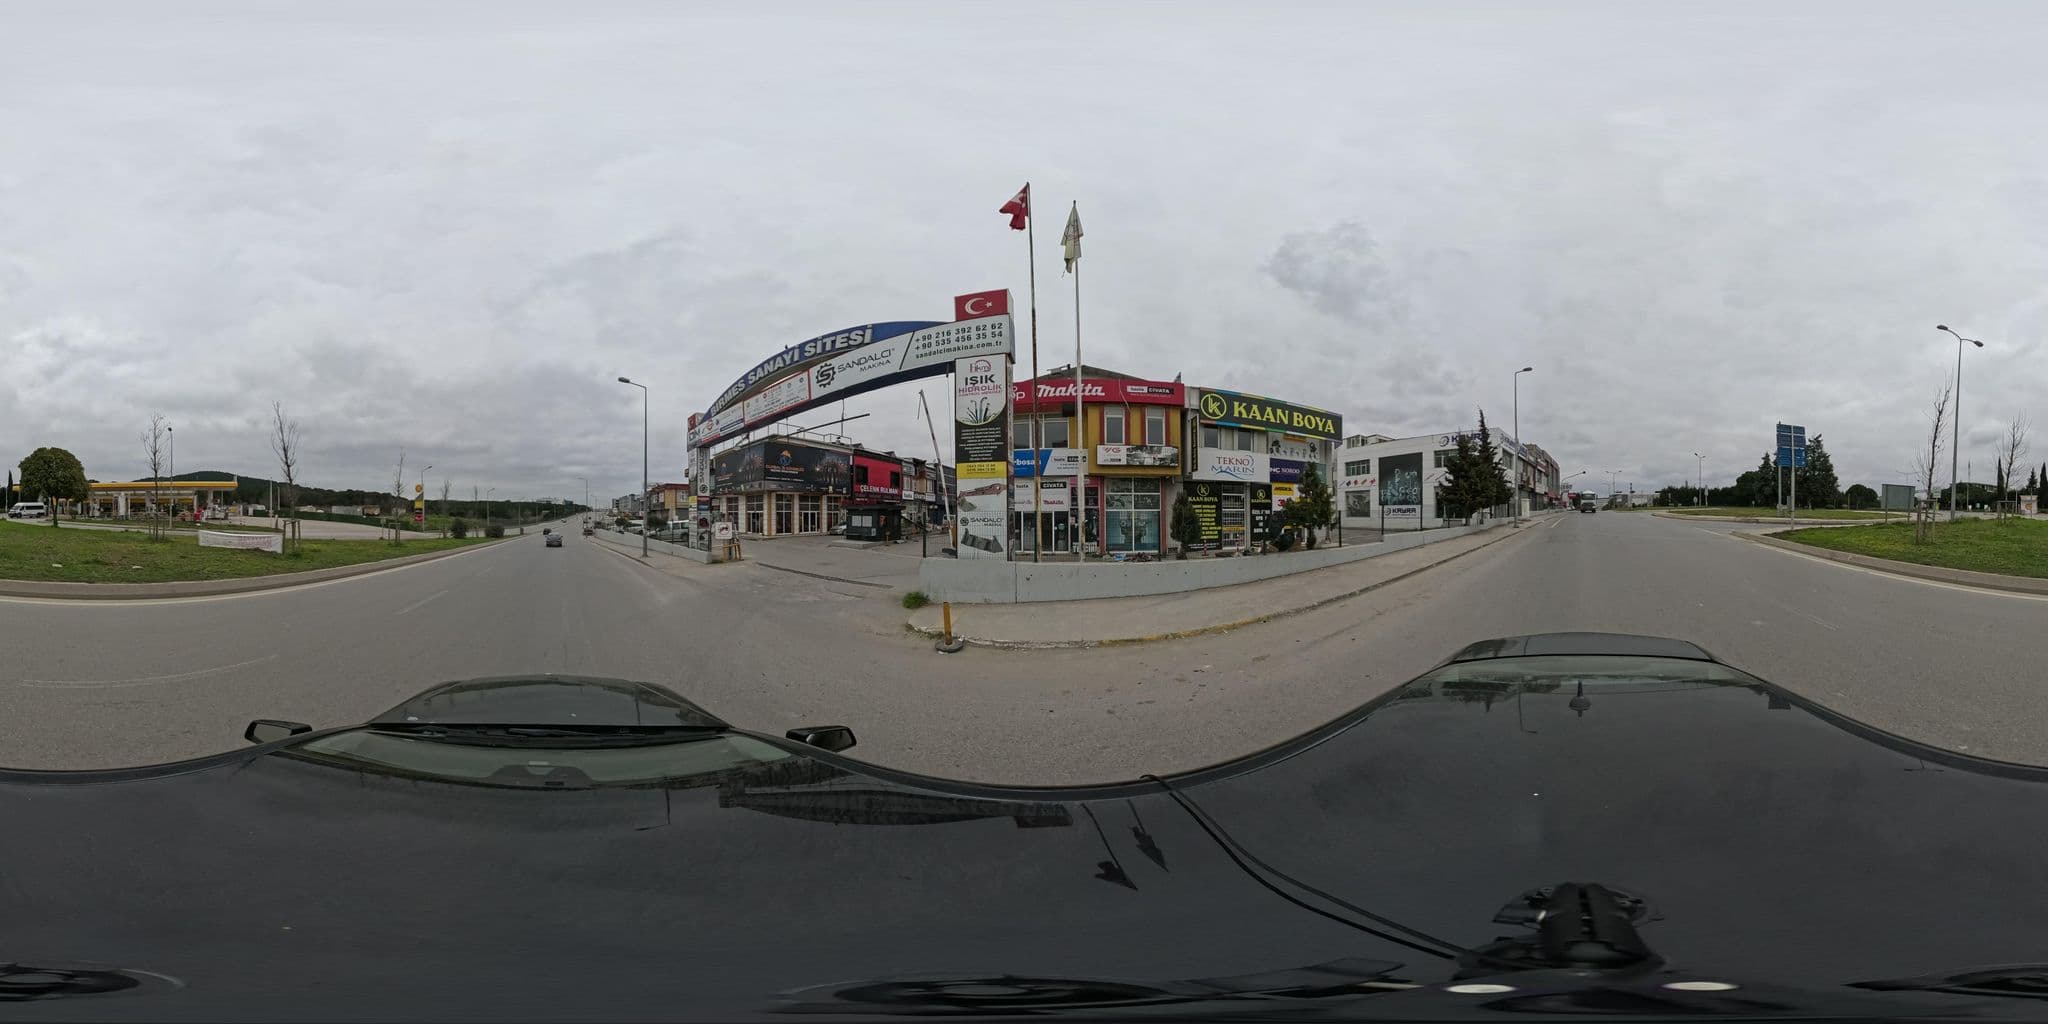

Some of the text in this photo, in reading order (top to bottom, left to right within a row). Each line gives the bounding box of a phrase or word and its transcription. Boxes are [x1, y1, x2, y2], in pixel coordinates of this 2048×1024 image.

[935, 330, 952, 339] 216
[955, 326, 972, 335] 392
[991, 322, 1003, 330] 62
[935, 337, 952, 347] 535
[955, 334, 972, 343] 456
[976, 332, 987, 340] 35
[991, 330, 1003, 338] 54
[748, 344, 800, 385] SANAYİ
[804, 324, 873, 358] SİTESİ
[1233, 401, 1336, 434] KAAN BOYA
[1216, 456, 1250, 466] TEKNO
